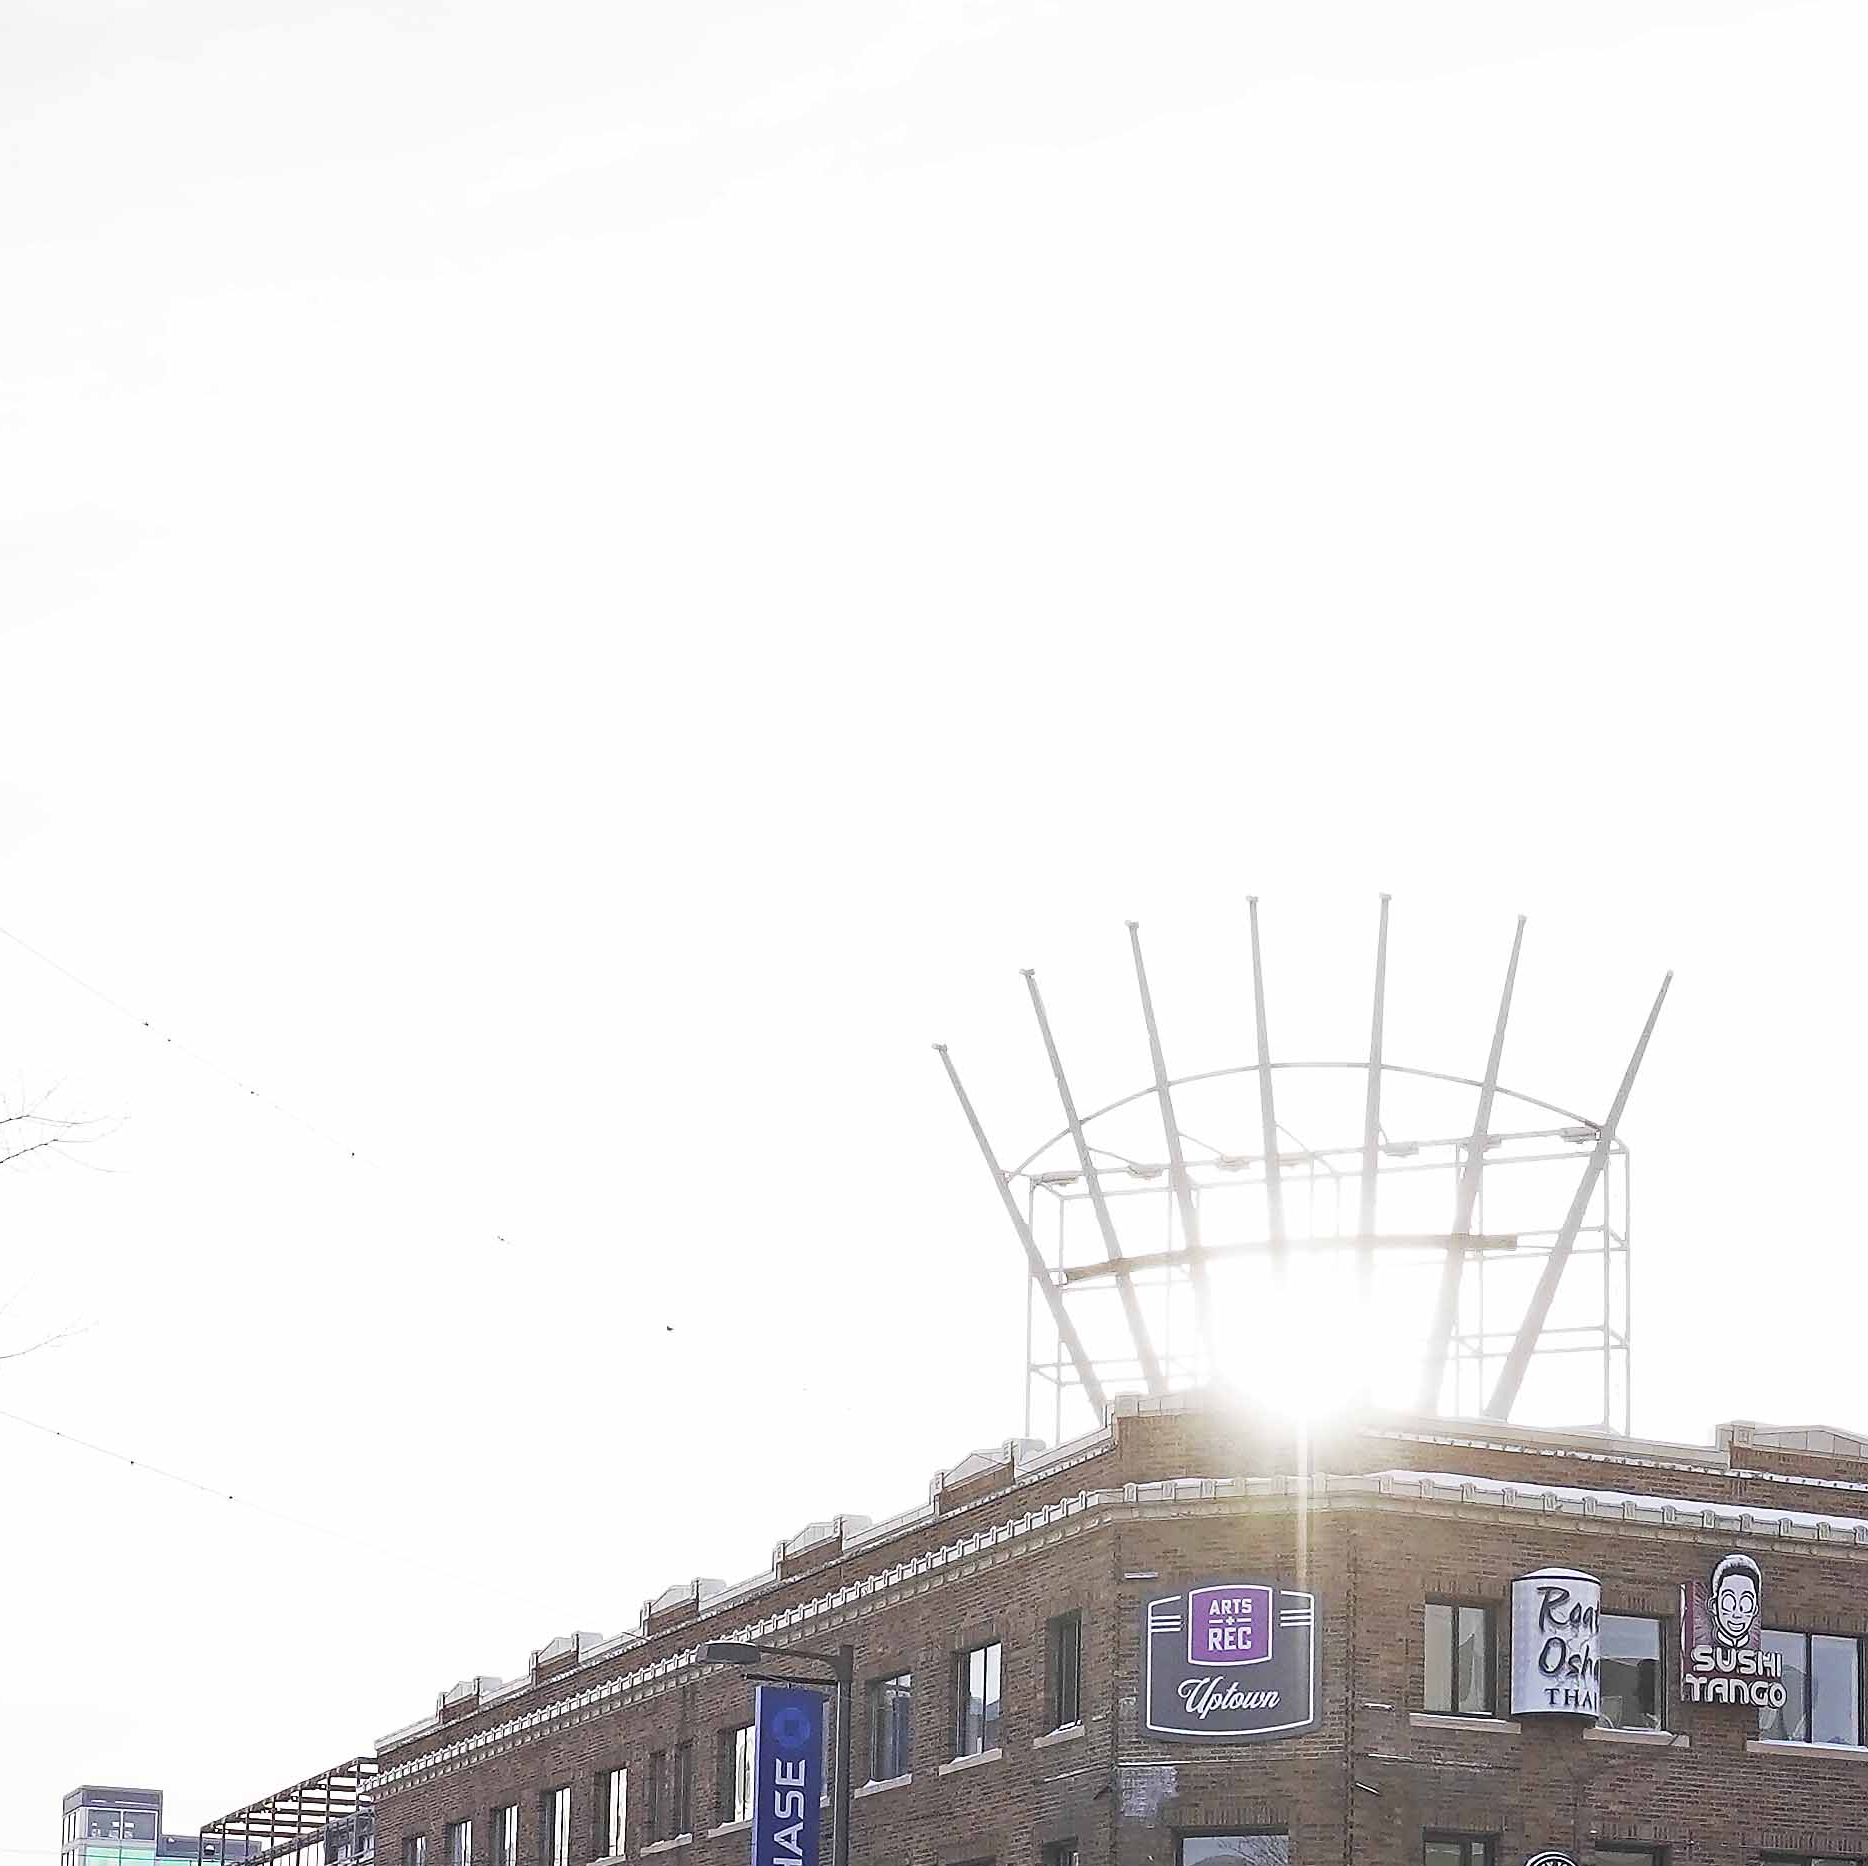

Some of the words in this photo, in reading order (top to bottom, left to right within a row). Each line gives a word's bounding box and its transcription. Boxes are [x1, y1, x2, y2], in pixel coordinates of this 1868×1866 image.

[1209, 1598, 1253, 1616] ARTS
[1208, 1626, 1252, 1651] REC
[1691, 1644, 1783, 1678] SUSHI
[1177, 1675, 1281, 1720] Uptown
[1544, 1688, 1598, 1712] THAI
[1684, 1673, 1788, 1709] TANGO
